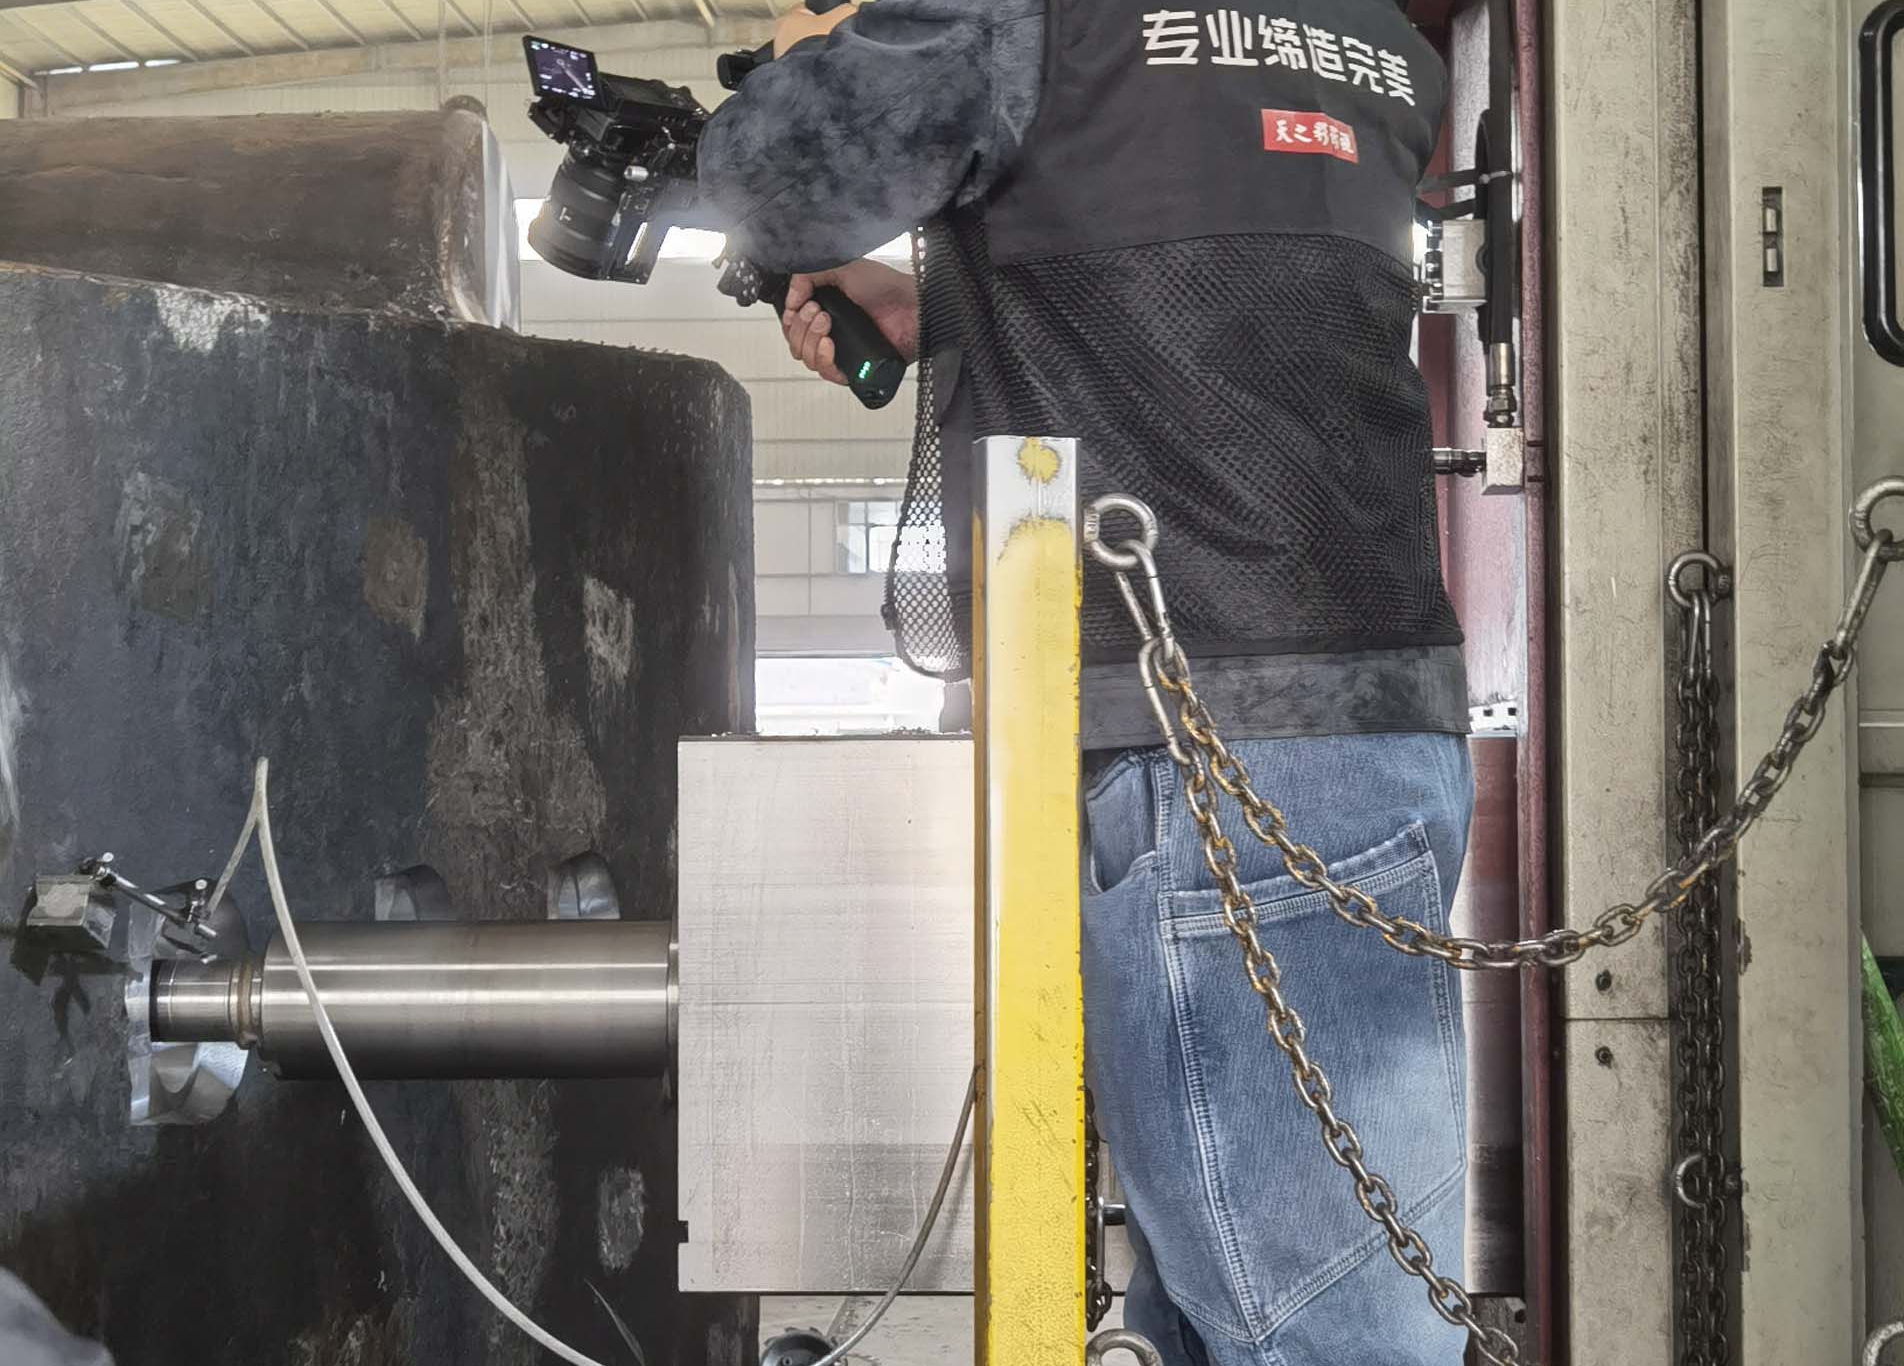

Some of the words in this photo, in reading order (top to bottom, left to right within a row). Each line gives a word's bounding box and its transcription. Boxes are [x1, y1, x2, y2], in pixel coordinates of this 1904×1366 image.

[1142, 9, 1415, 106] 专业缔造完美
